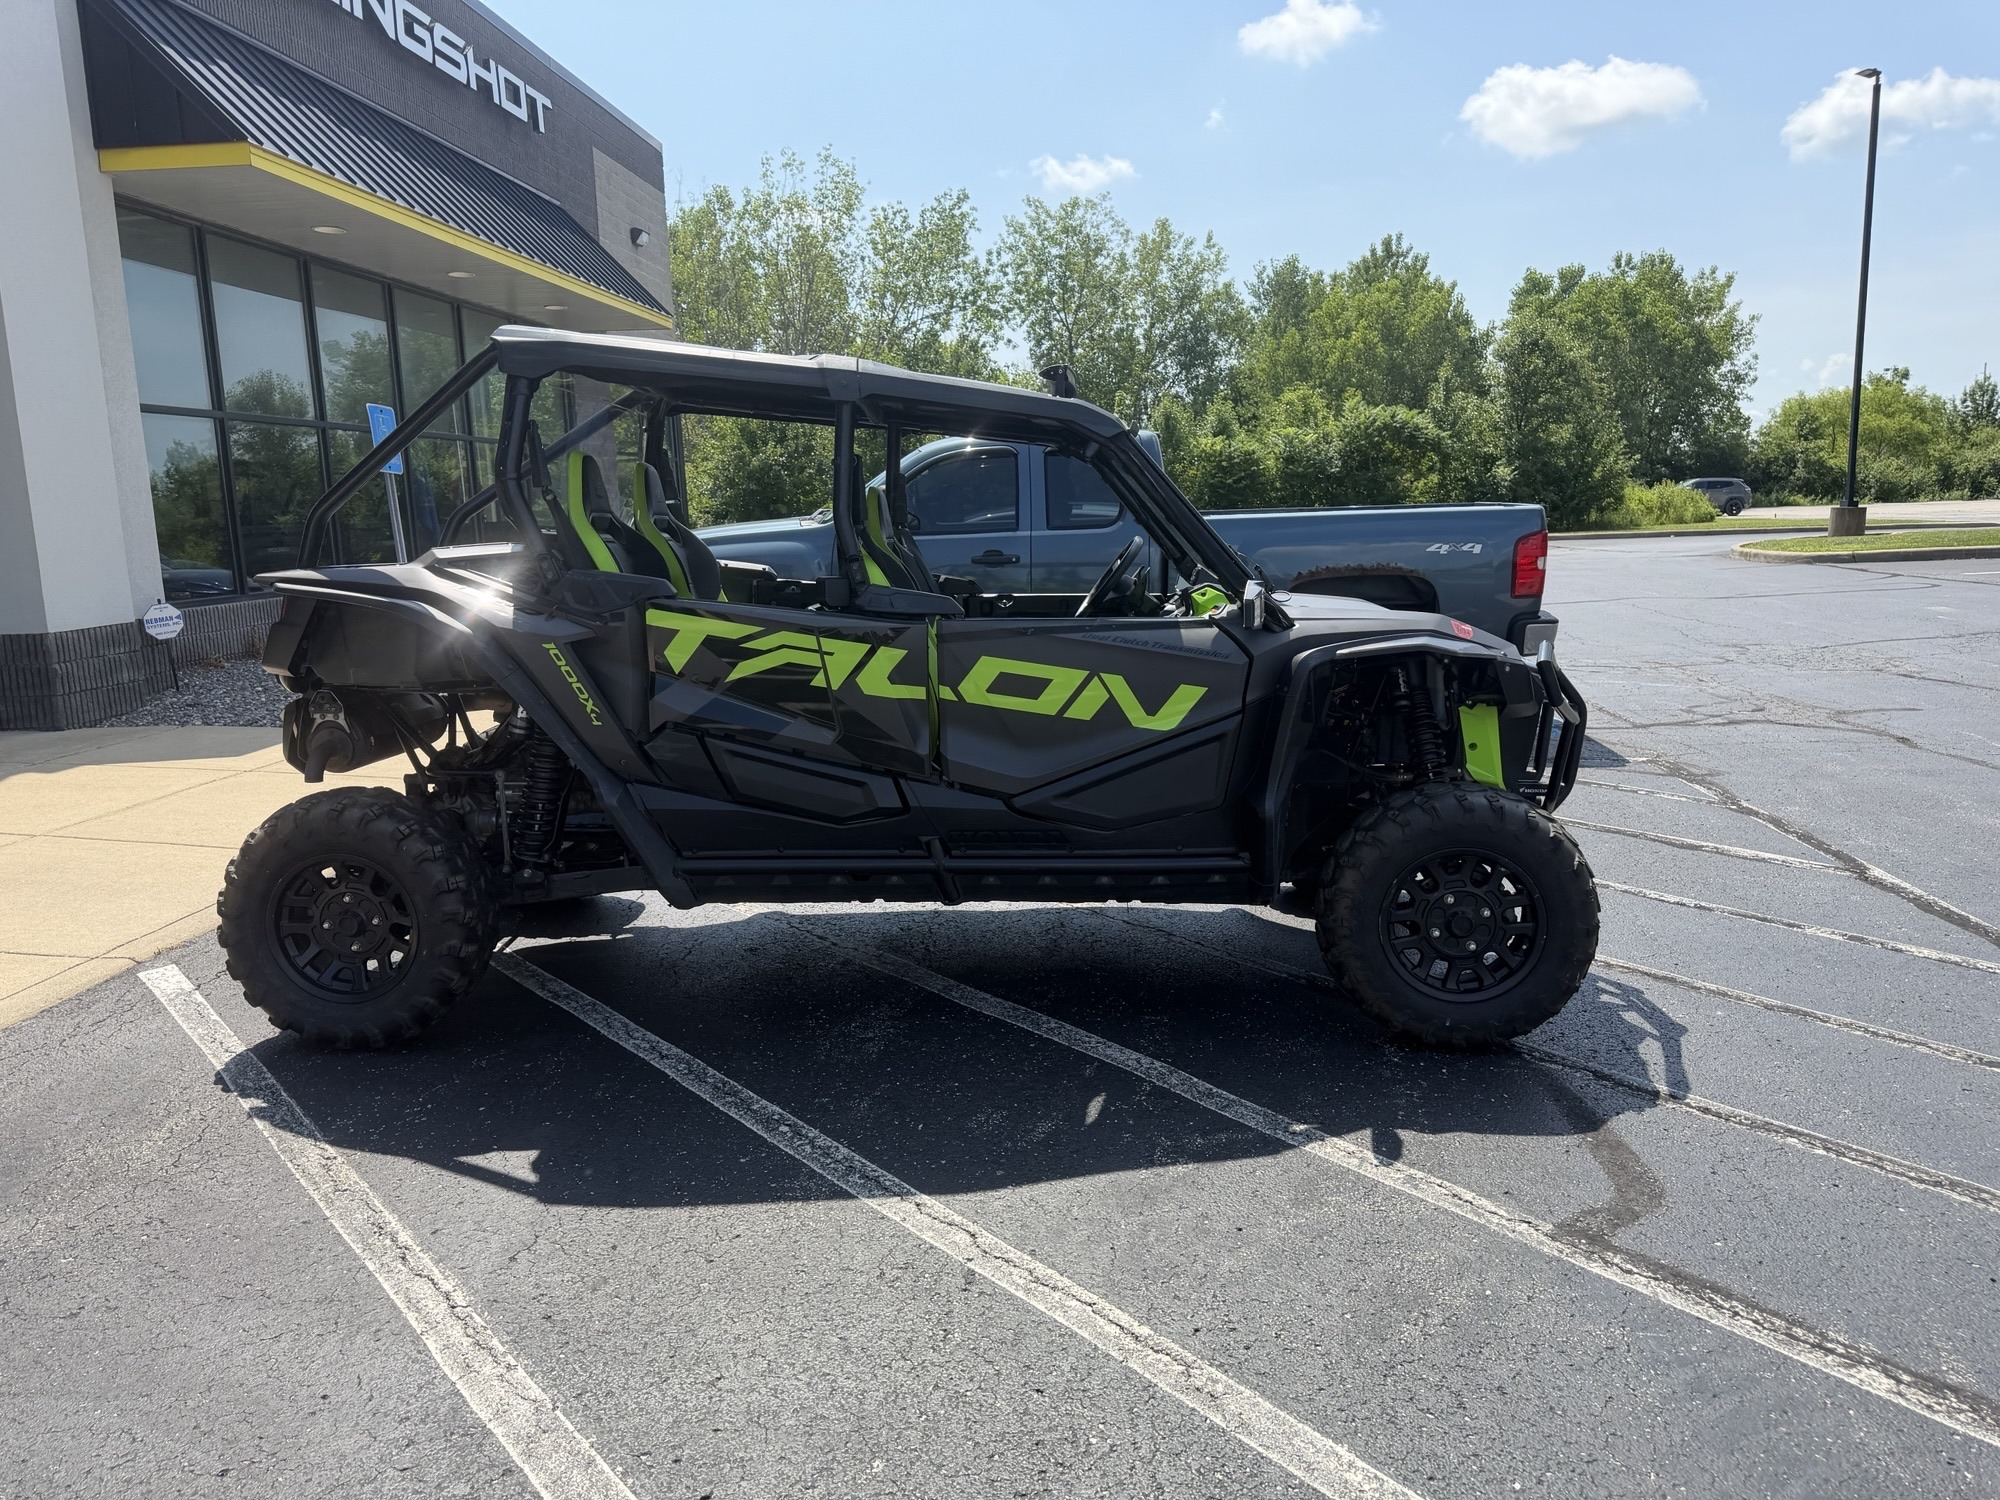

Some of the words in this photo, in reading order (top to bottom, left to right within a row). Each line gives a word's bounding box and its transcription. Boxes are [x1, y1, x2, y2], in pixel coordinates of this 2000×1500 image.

[145, 615, 174, 625] REBMAN
[1083, 632, 1110, 641] Dual
[1112, 636, 1149, 647] Clutch
[1151, 641, 1231, 660] Transmission
[645, 608, 1209, 731] TALON
